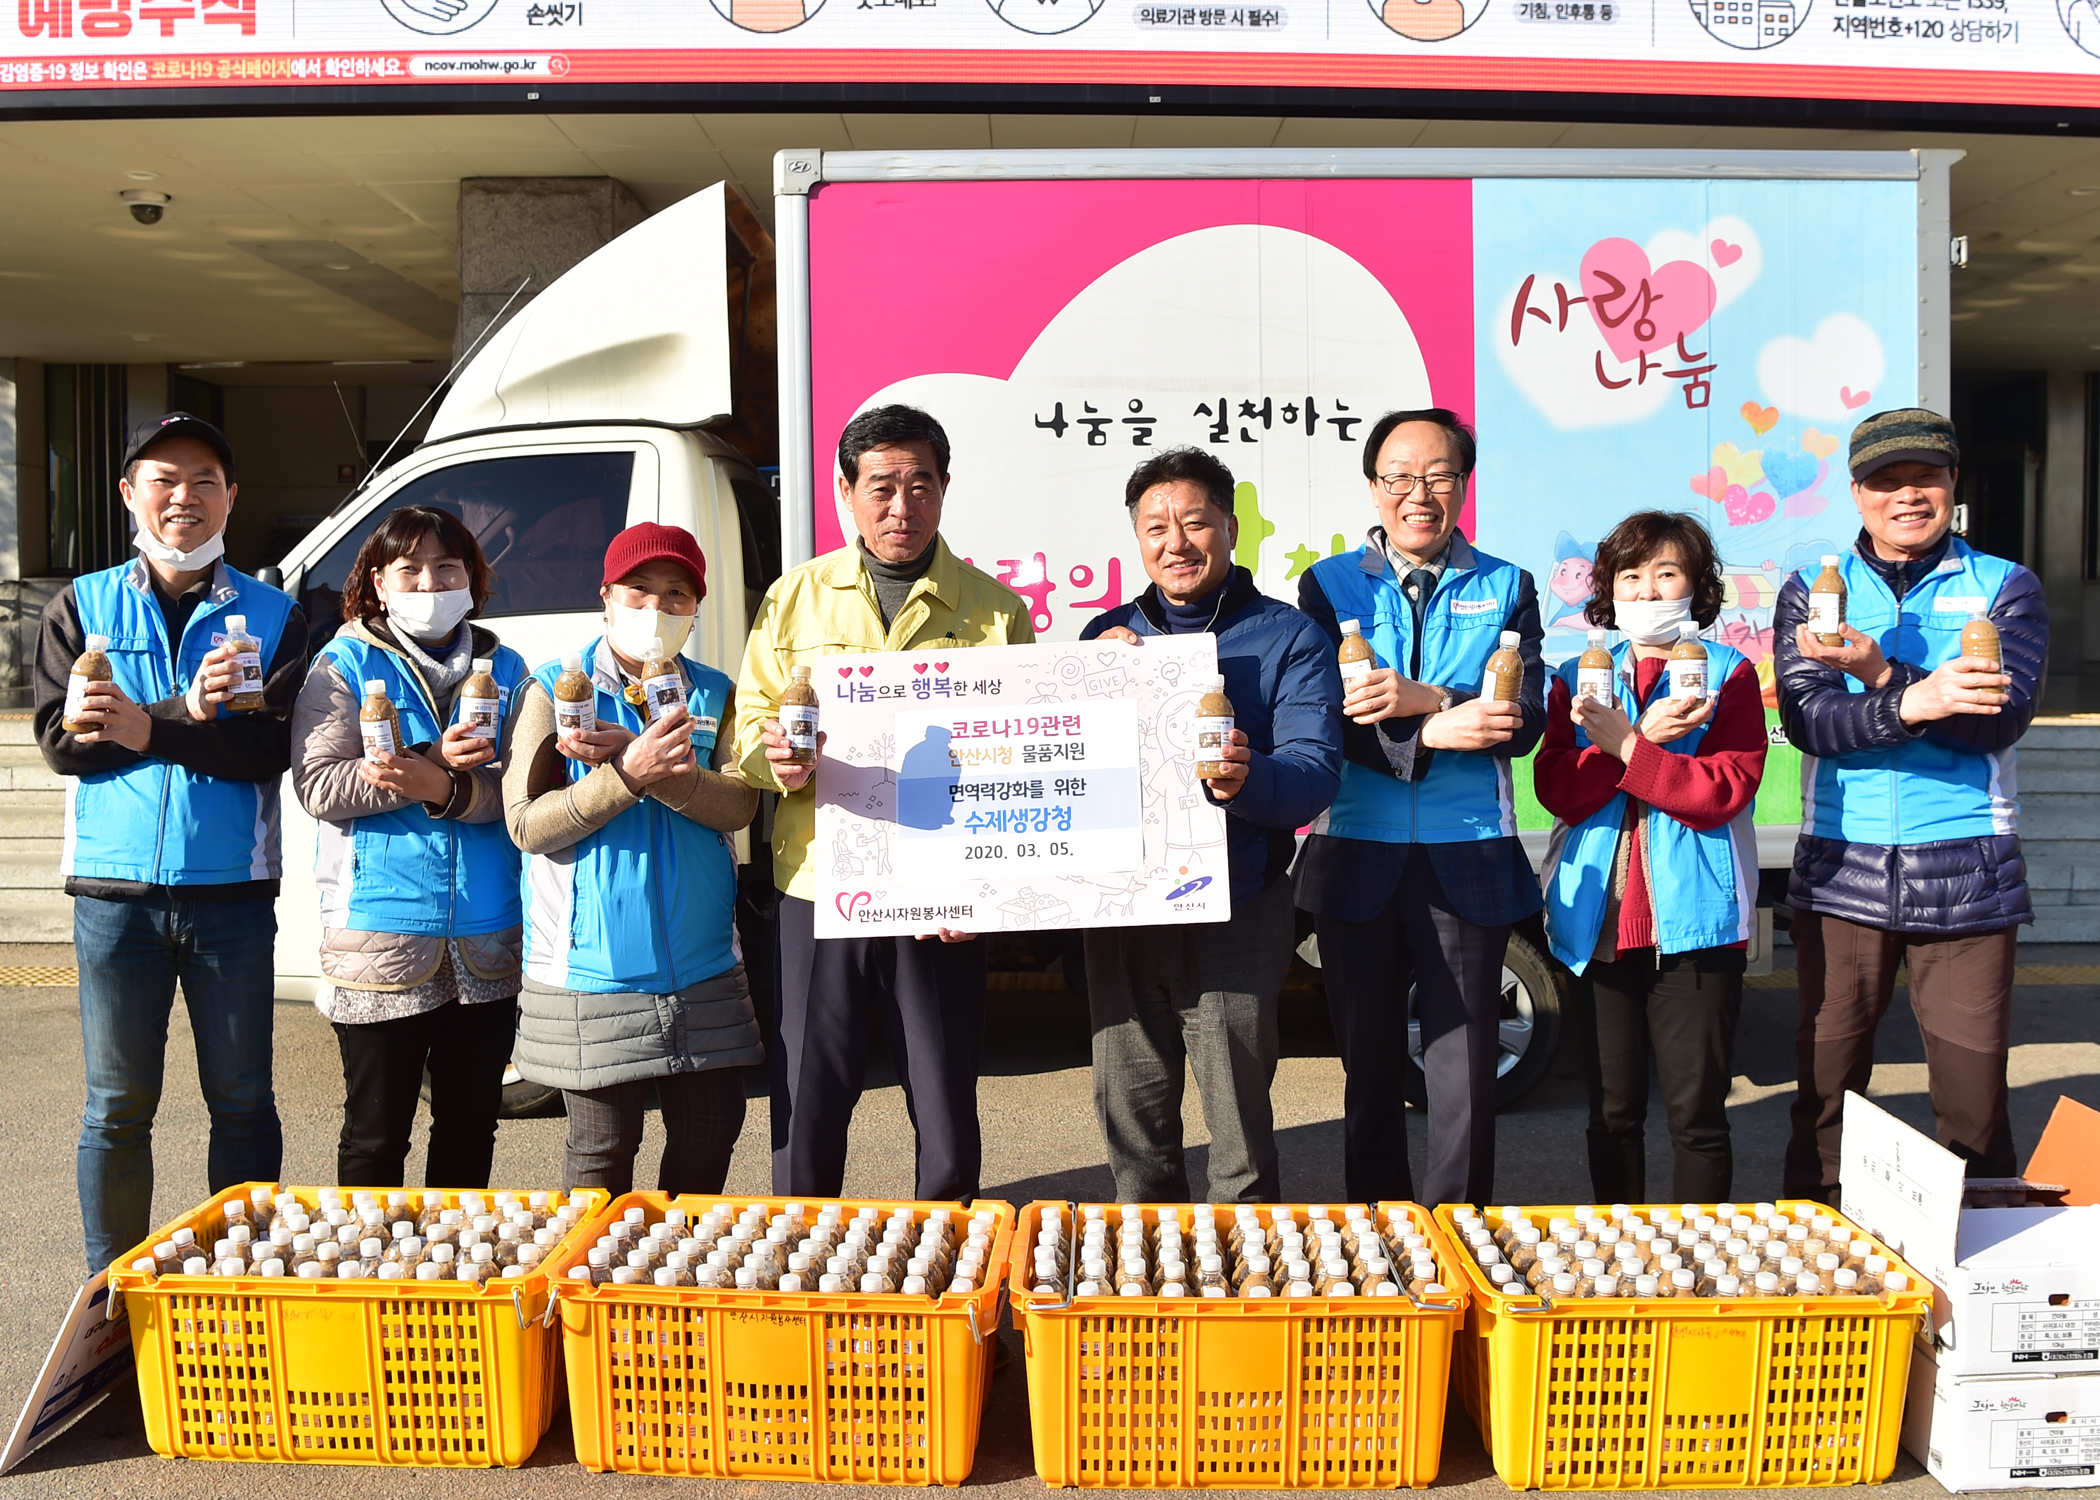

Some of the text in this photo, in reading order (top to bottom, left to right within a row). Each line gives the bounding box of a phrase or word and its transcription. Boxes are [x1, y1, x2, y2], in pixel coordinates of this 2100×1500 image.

[526, 2, 583, 27] 손씻기
[1140, 8, 1197, 26] 의료기관
[1200, 8, 1227, 26] 방문
[1231, 8, 1244, 27] 시
[1832, 15, 2019, 44] 지역번호+120 상담하기
[69, 62, 100, 81] 정보
[103, 61, 148, 81] 확인은
[151, 60, 213, 80] 코로나19
[216, 57, 321, 79] 공식페이지에서
[325, 57, 405, 79] 확인하세요.
[424, 59, 537, 73] ncov.mohw.go.kr
[1510, 268, 1664, 347] 사랑
[1594, 330, 1718, 410] 나눔
[1035, 397, 1363, 447] 나눔을 실천하는
[963, 551, 1122, 634] 랑의
[837, 676, 1003, 704] 나눔으로 행복한 세상
[1088, 676, 1121, 691] GIVE
[951, 714, 1082, 739] 코로나19관련
[948, 742, 1086, 767] 안산시청 물품지원
[948, 777, 1088, 802] 면역력강화를 위한
[964, 804, 1073, 835] 수제생강청
[964, 841, 1074, 860] 2020. 03. 05.
[858, 904, 974, 923] 안산시자원봉사센터
[1173, 901, 1206, 912] 안산시
[1972, 1281, 1996, 1295] Jeju
[1971, 1399, 1995, 1412] Jeju
[2012, 1469, 2027, 1477] NH
